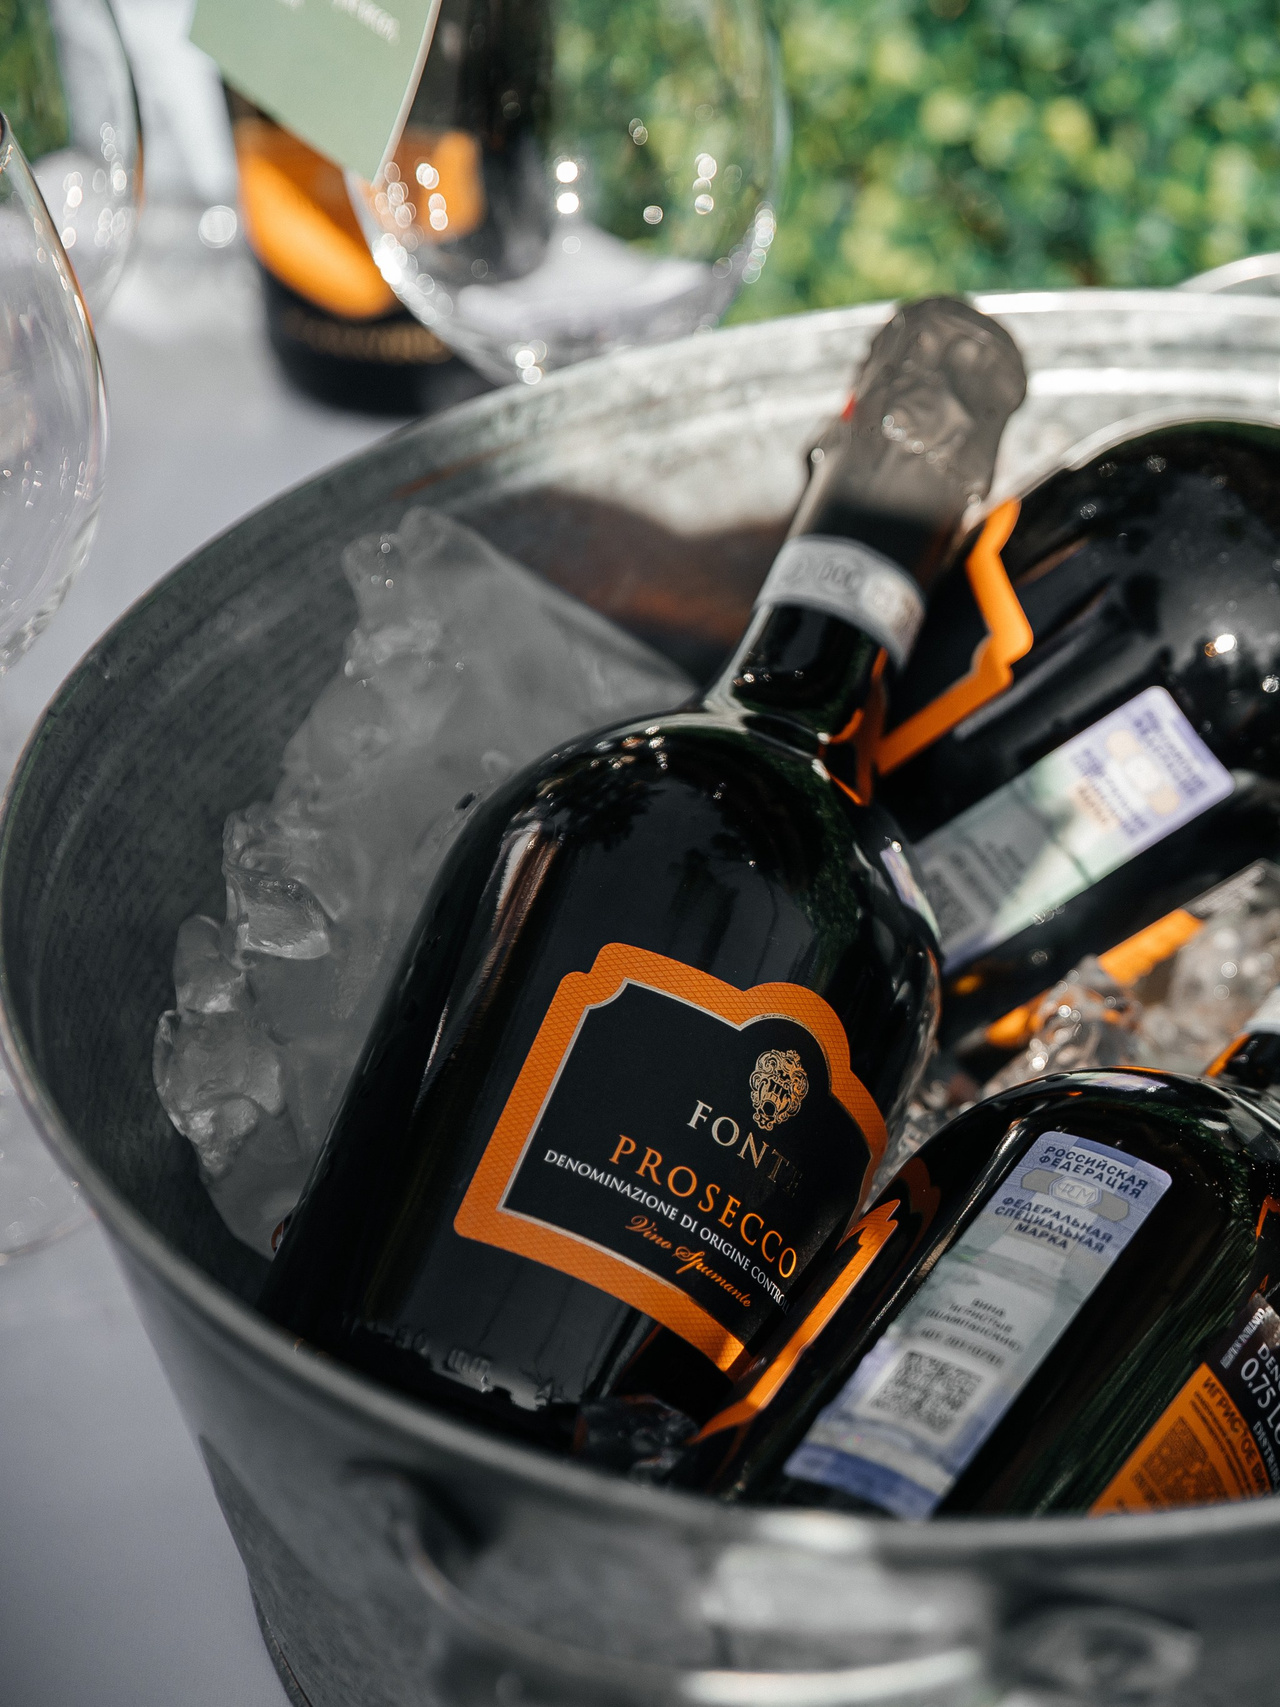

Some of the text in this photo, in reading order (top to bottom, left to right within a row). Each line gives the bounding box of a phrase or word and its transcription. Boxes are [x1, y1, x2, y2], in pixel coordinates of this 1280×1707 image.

[687, 1100, 803, 1198] FONTE
[1044, 1145, 1149, 1191] РОССИЙСКАЯ
[1039, 1155, 1142, 1200] ФЕДЕРАЦИЯ
[544, 1149, 679, 1222] DENOMINAZIONE
[679, 1213, 699, 1233] DI
[699, 1227, 751, 1271] ORIGINE
[609, 1134, 798, 1279] PROSECCO
[994, 1206, 1106, 1253] СПЕЦИАЛЬНАЯ
[1002, 1196, 1113, 1244] ФЕДЕРАЛЬНАЯ
[625, 1214, 751, 1308] Vino Spumante
[1014, 1222, 1069, 1250] МАРКА
[1240, 1357, 1277, 1409] 0.75
